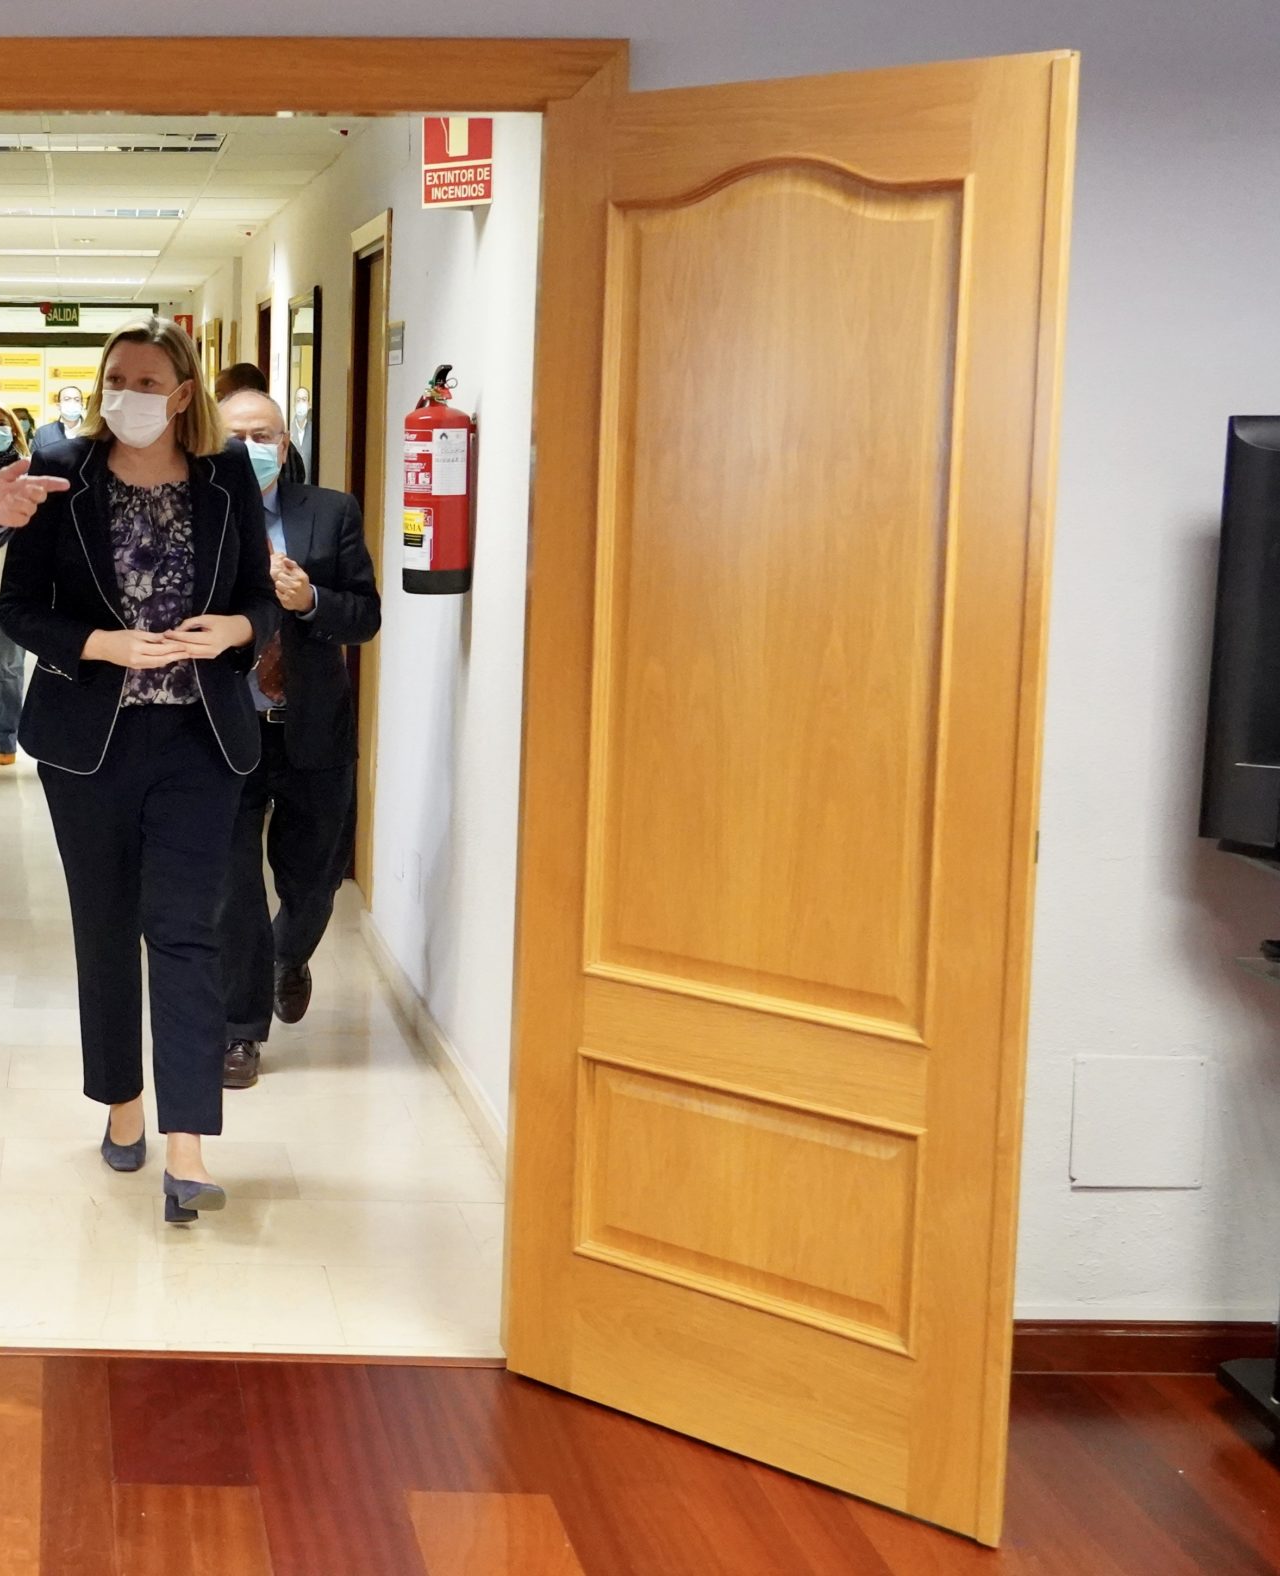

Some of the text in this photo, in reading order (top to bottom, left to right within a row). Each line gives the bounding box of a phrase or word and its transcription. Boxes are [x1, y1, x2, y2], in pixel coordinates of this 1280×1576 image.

[426, 167, 490, 185] EXTINTOR DE
[431, 183, 484, 200] INCENDIOS
[46, 307, 78, 322] SALIDA
